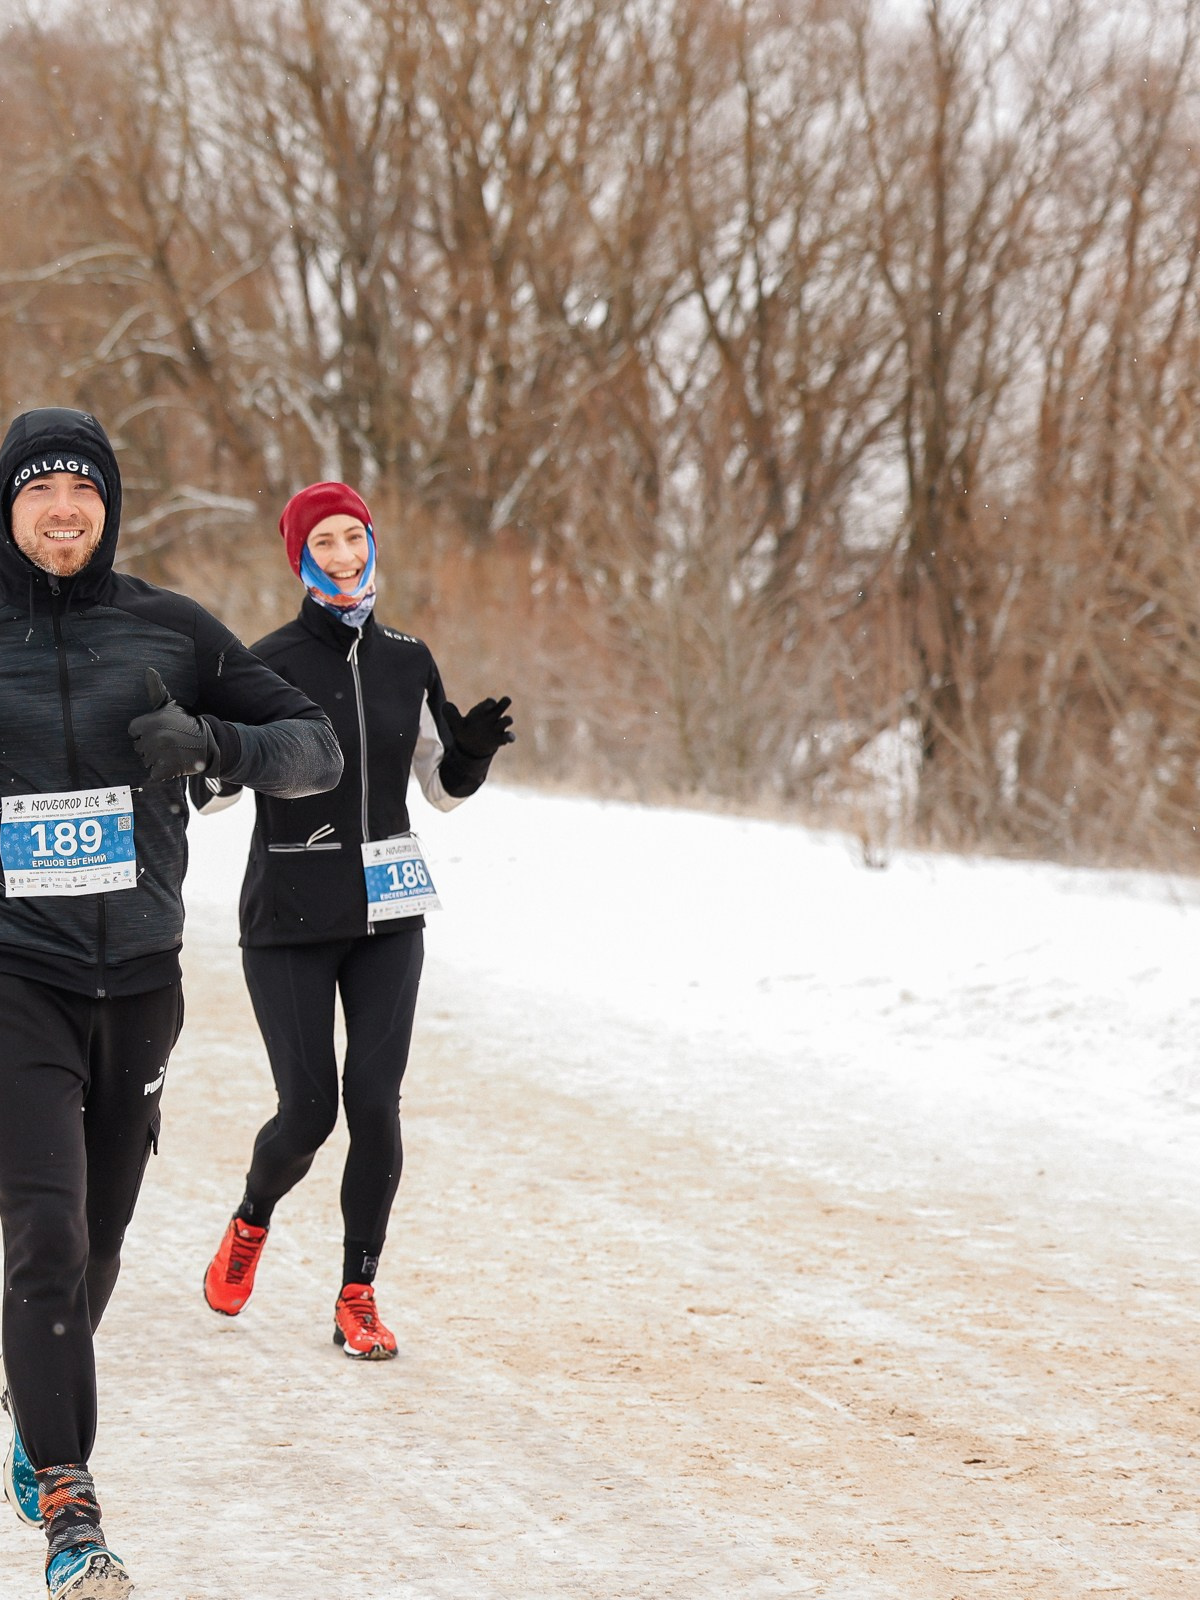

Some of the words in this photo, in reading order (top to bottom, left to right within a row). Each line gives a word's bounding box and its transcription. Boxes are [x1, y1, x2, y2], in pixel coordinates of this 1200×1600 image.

[14, 459, 90, 487] COLLAGE
[31, 797, 82, 811] NOVGOROD
[84, 795, 100, 808] ICE
[30, 819, 103, 857] 189
[32, 859, 65, 868] ЕРШОВ
[66, 854, 107, 867] ЕВГЕНИЙ
[387, 861, 427, 891] 186
